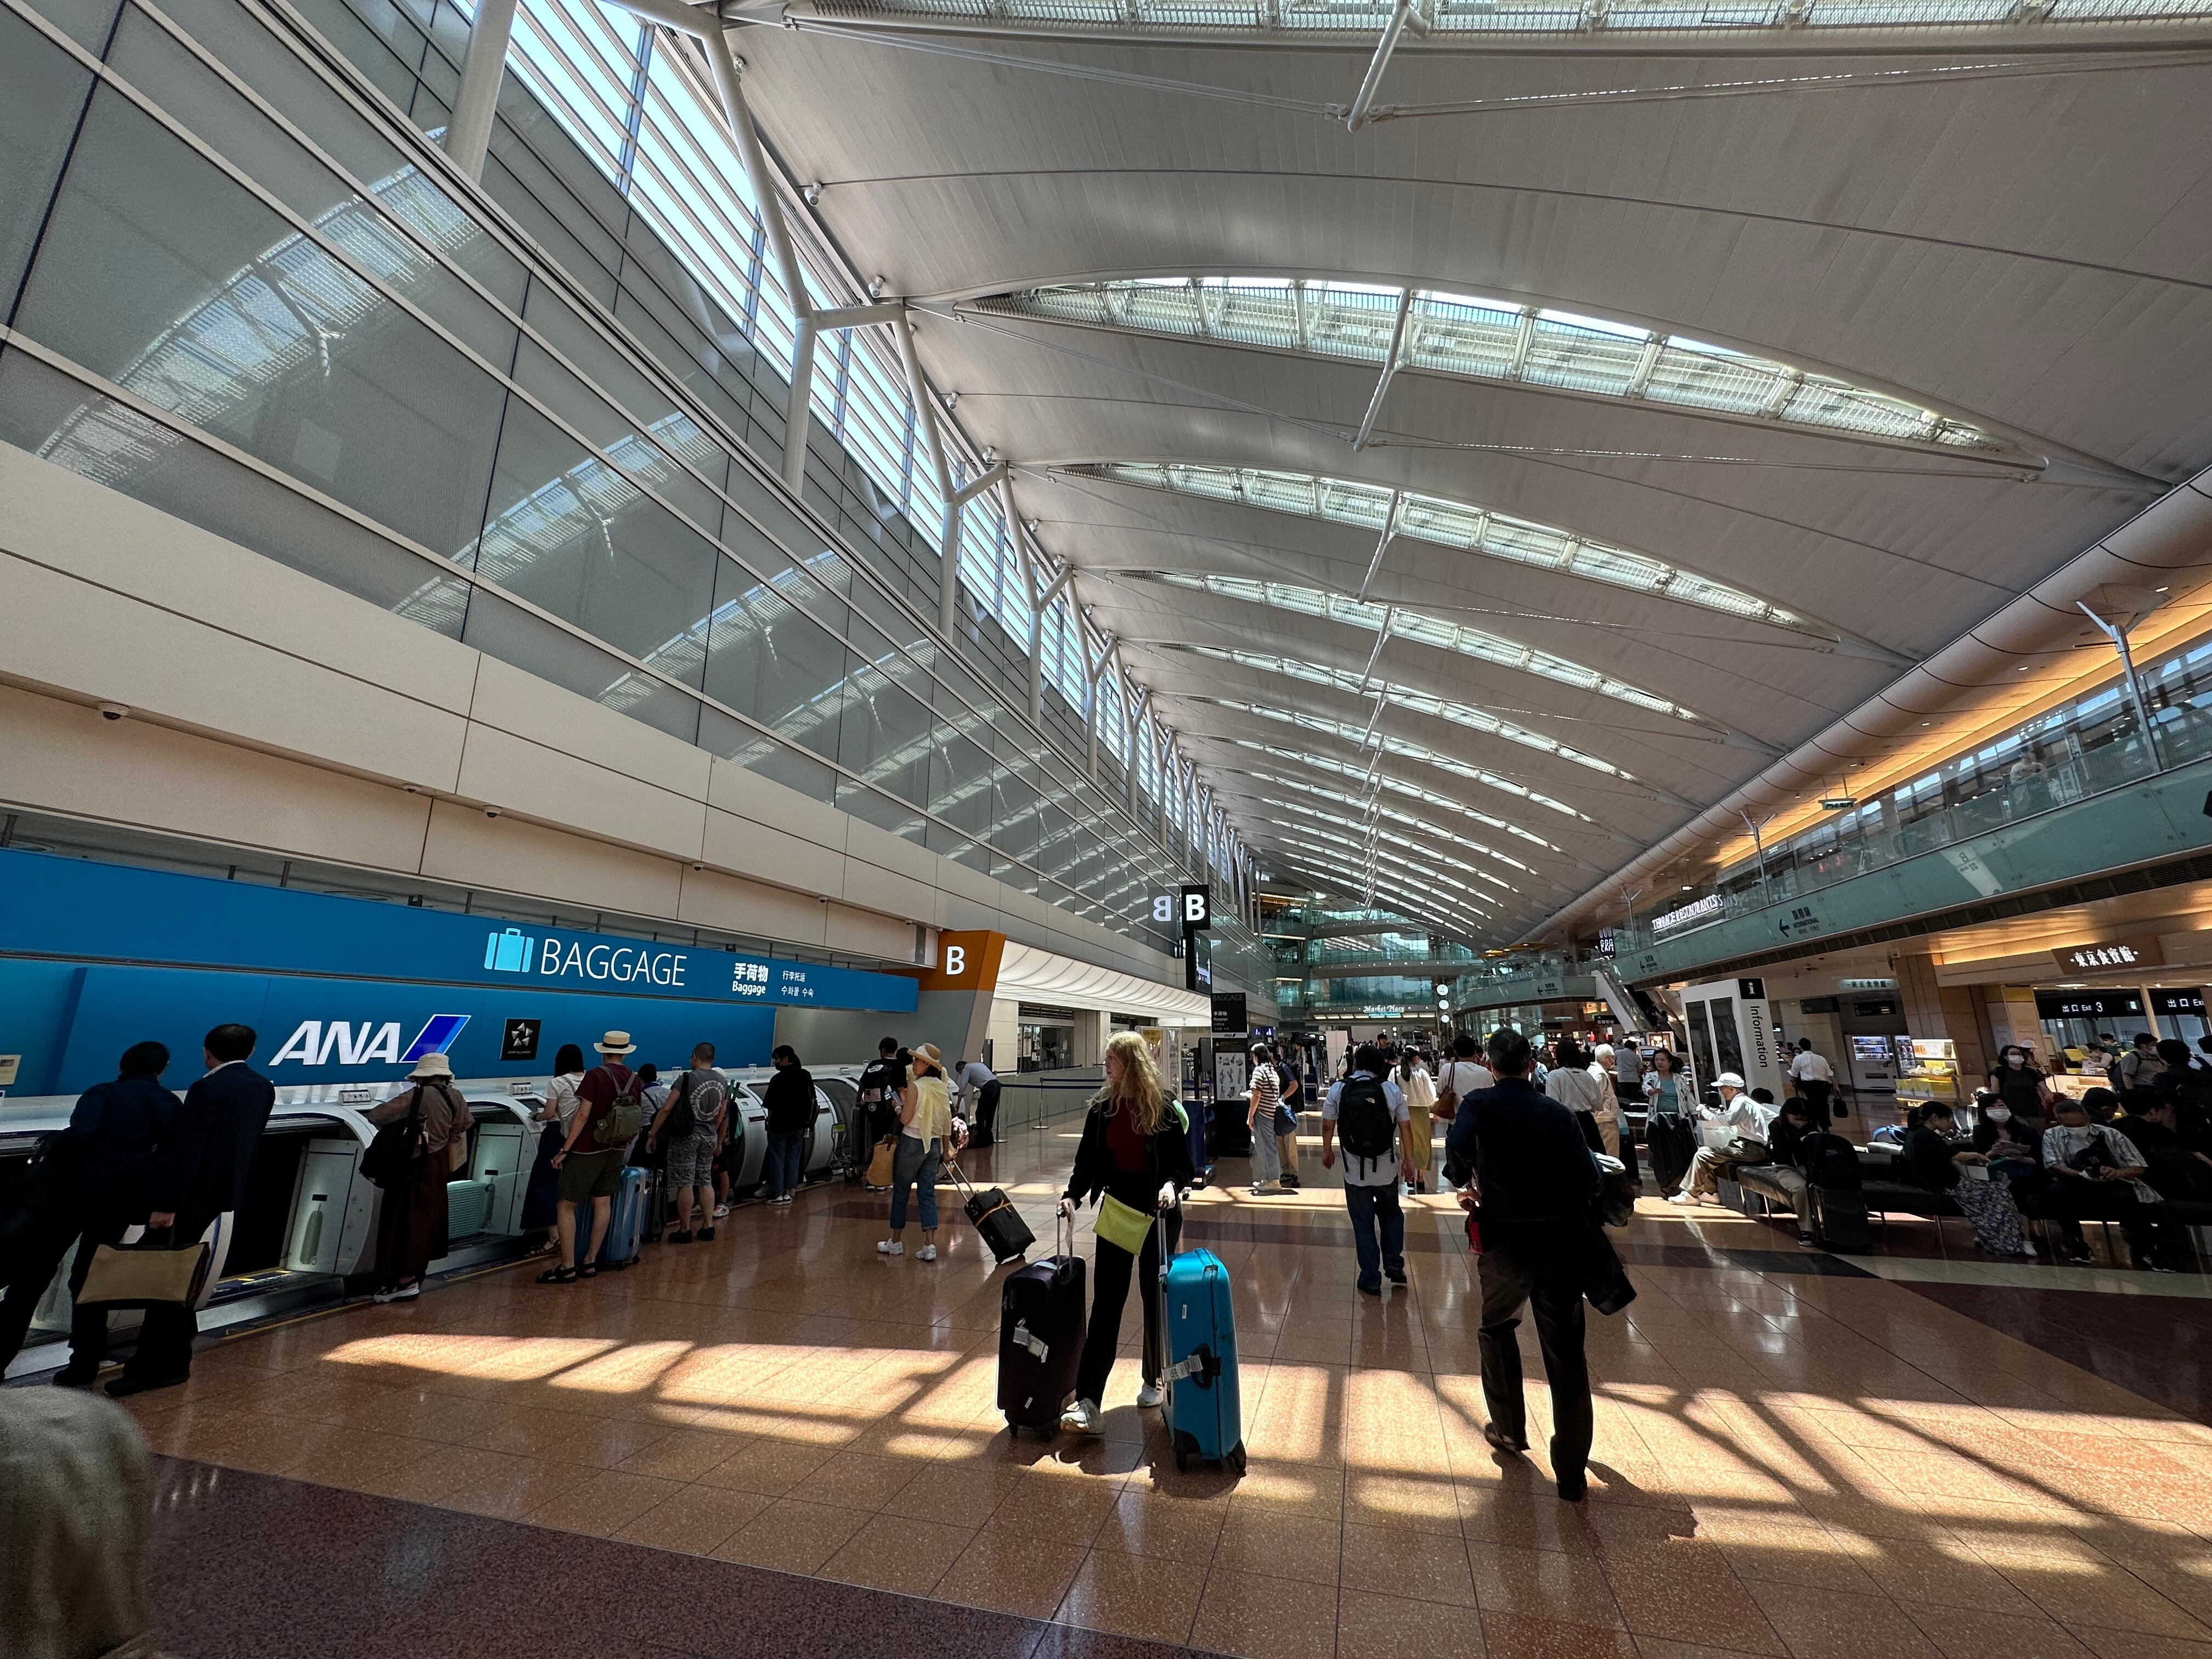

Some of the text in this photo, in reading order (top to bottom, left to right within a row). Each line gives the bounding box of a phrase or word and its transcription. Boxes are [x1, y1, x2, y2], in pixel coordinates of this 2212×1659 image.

[1186, 894, 1205, 921] B
[1601, 944, 1615, 952] CAFE
[540, 939, 687, 986] BAGGAGE
[946, 946, 964, 975] B
[733, 962, 769, 983] 手荷物
[782, 970, 806, 982] 行李托运
[732, 980, 766, 996] Baggage
[781, 985, 814, 997] 수화물 수속
[2062, 1004, 2079, 1012] 出口
[2096, 1002, 2103, 1012] 3
[2167, 998, 2189, 1007] 出口
[268, 1021, 400, 1065] ANA
[1750, 1006, 1768, 1068] Information
